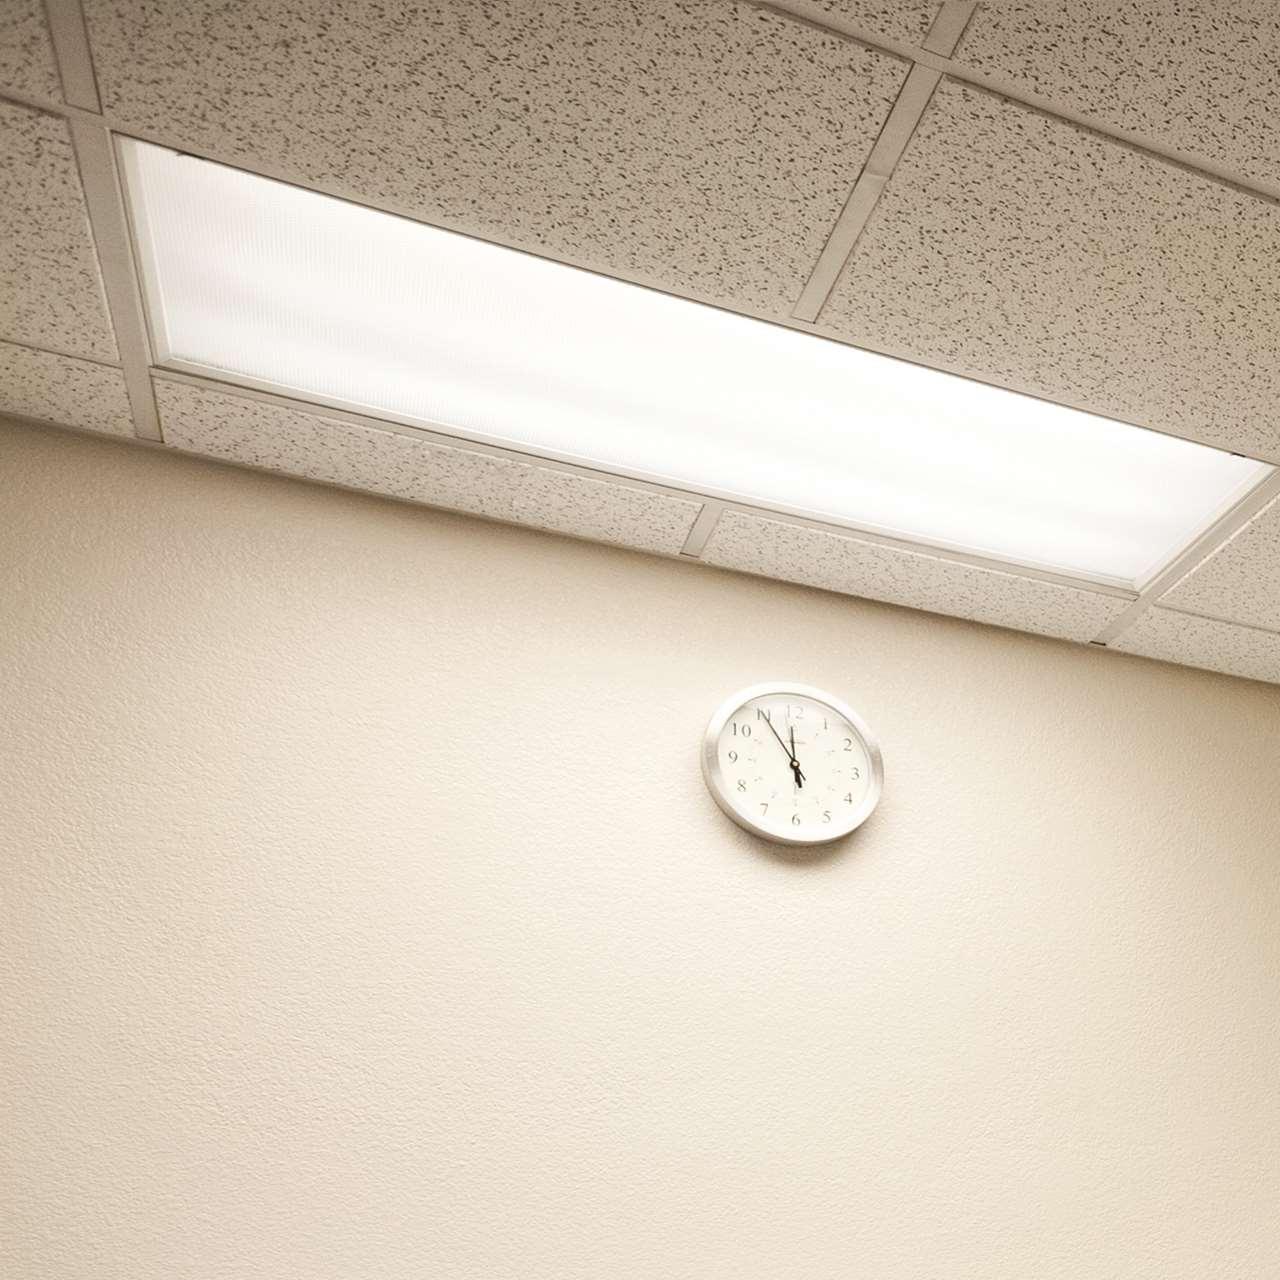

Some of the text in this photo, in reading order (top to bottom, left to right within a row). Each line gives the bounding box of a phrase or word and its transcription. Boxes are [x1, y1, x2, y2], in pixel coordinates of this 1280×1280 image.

[786, 704, 804, 720] 12
[732, 722, 751, 737] 10
[822, 717, 829, 730] 1
[843, 738, 853, 752] 2
[728, 751, 738, 764] 9
[851, 767, 860, 781] 3
[737, 779, 747, 793] 8
[843, 792, 853, 805] 4
[759, 803, 769, 817] 7
[823, 810, 832, 824] 5
[792, 813, 801, 826] 6
